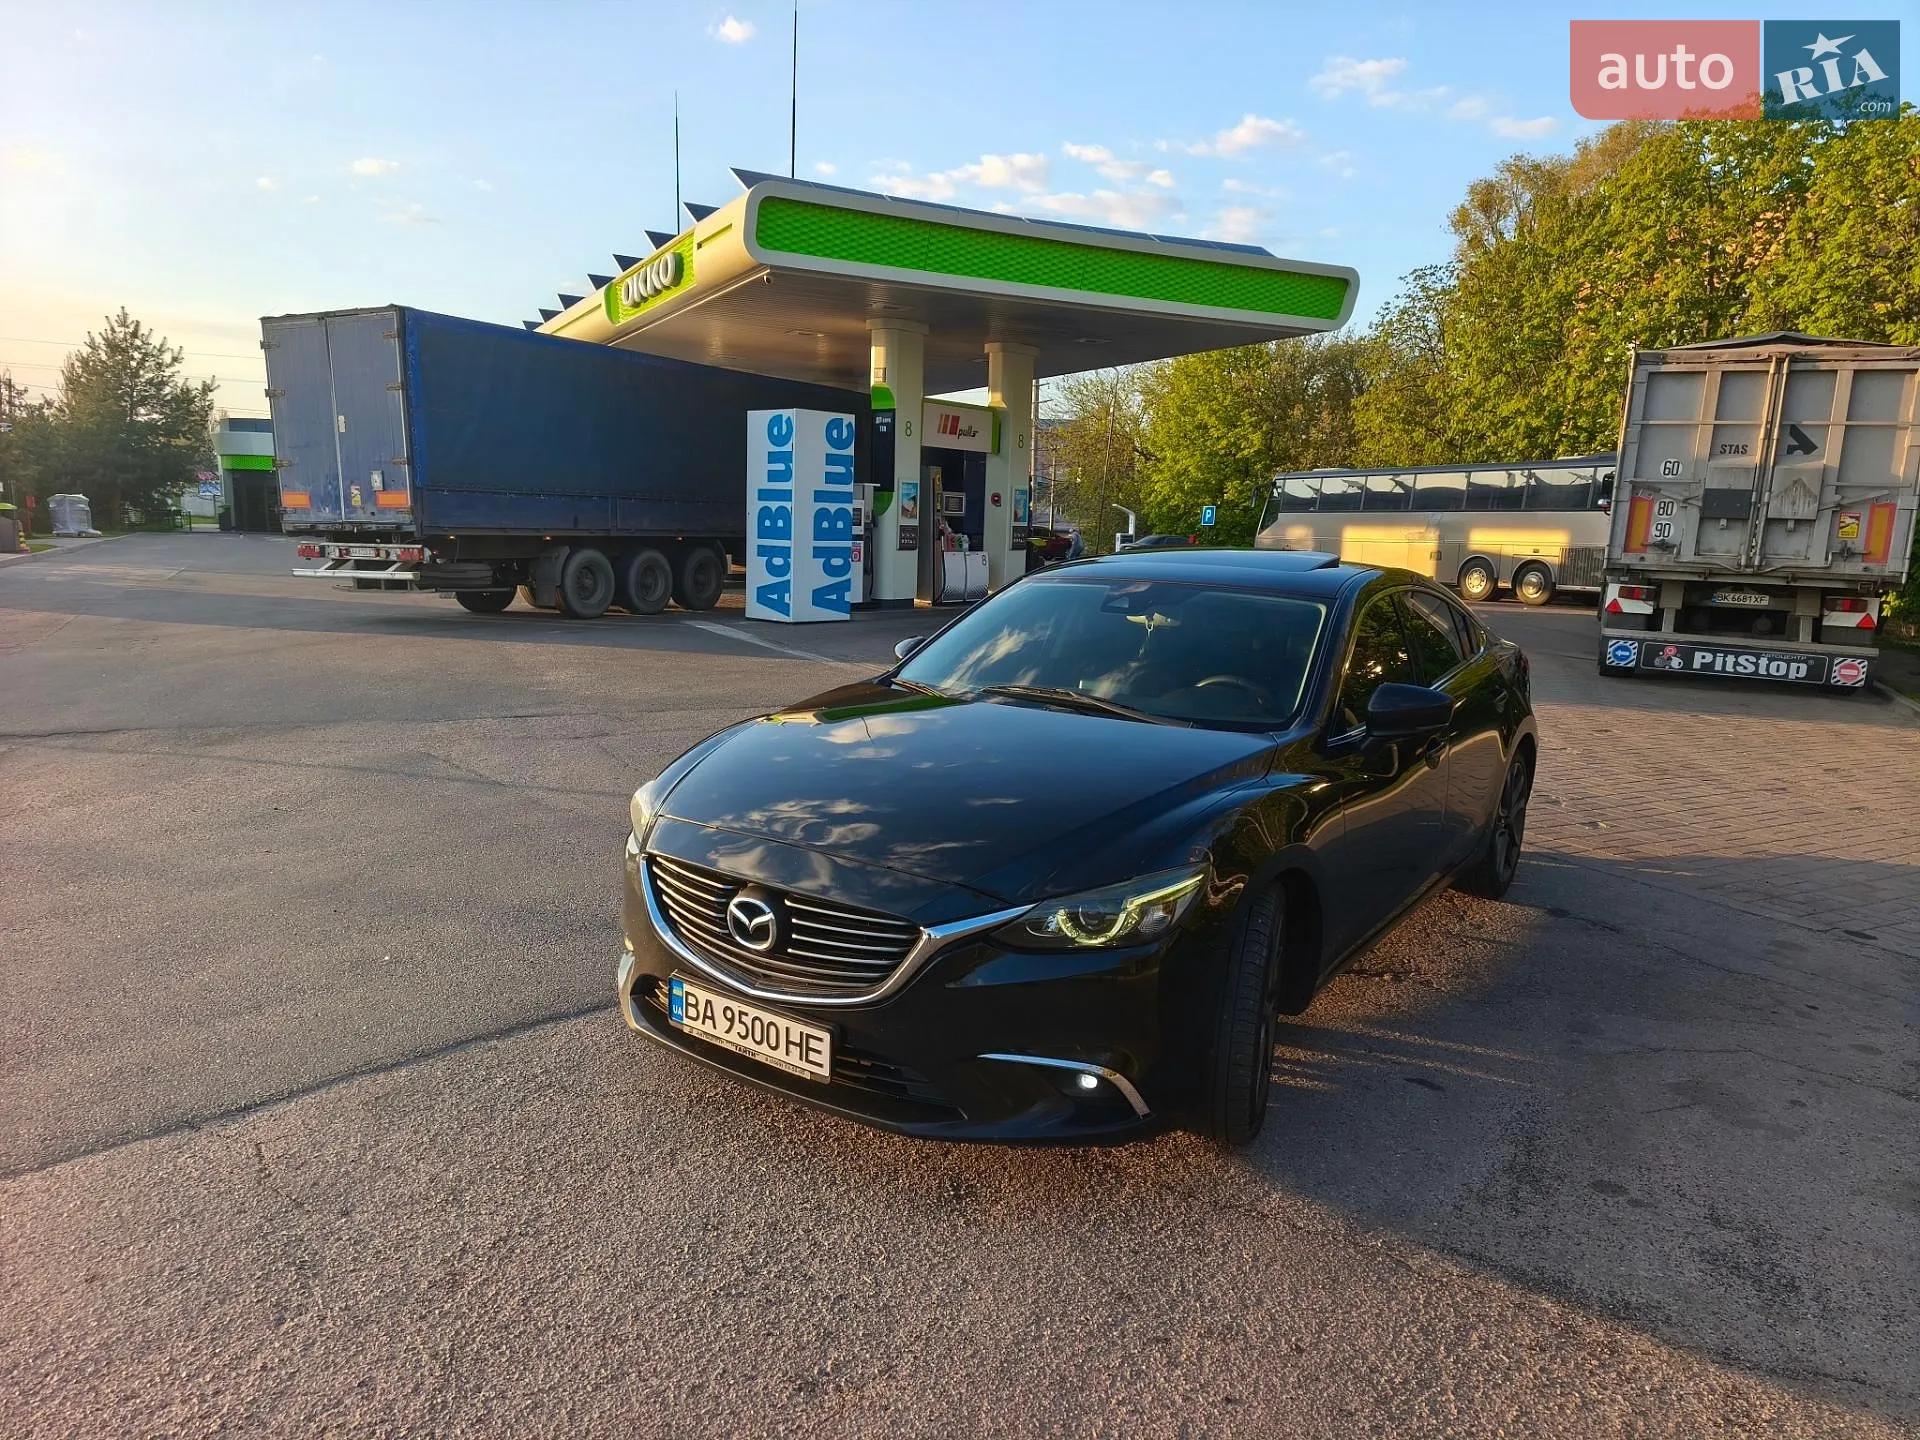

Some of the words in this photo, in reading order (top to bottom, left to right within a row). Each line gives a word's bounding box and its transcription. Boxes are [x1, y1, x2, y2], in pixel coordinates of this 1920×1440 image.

[621, 251, 676, 307] OKKO
[905, 420, 912, 437] 8
[1018, 433, 1024, 448] 8
[1719, 444, 1749, 455] STAS
[1663, 460, 1680, 476] 60
[757, 414, 793, 618] AdBlue
[812, 417, 855, 615] AdBlue
[1205, 509, 1212, 522] P
[1657, 500, 1674, 516] 80
[1654, 522, 1671, 538] 90
[981, 554, 987, 566] 8
[1731, 594, 1752, 603] 6681
[1692, 650, 1809, 680] PitStop
[673, 1004, 682, 1016] UA
[684, 990, 717, 1030] BA
[722, 1005, 780, 1051] 9500
[785, 1028, 824, 1069] HE
